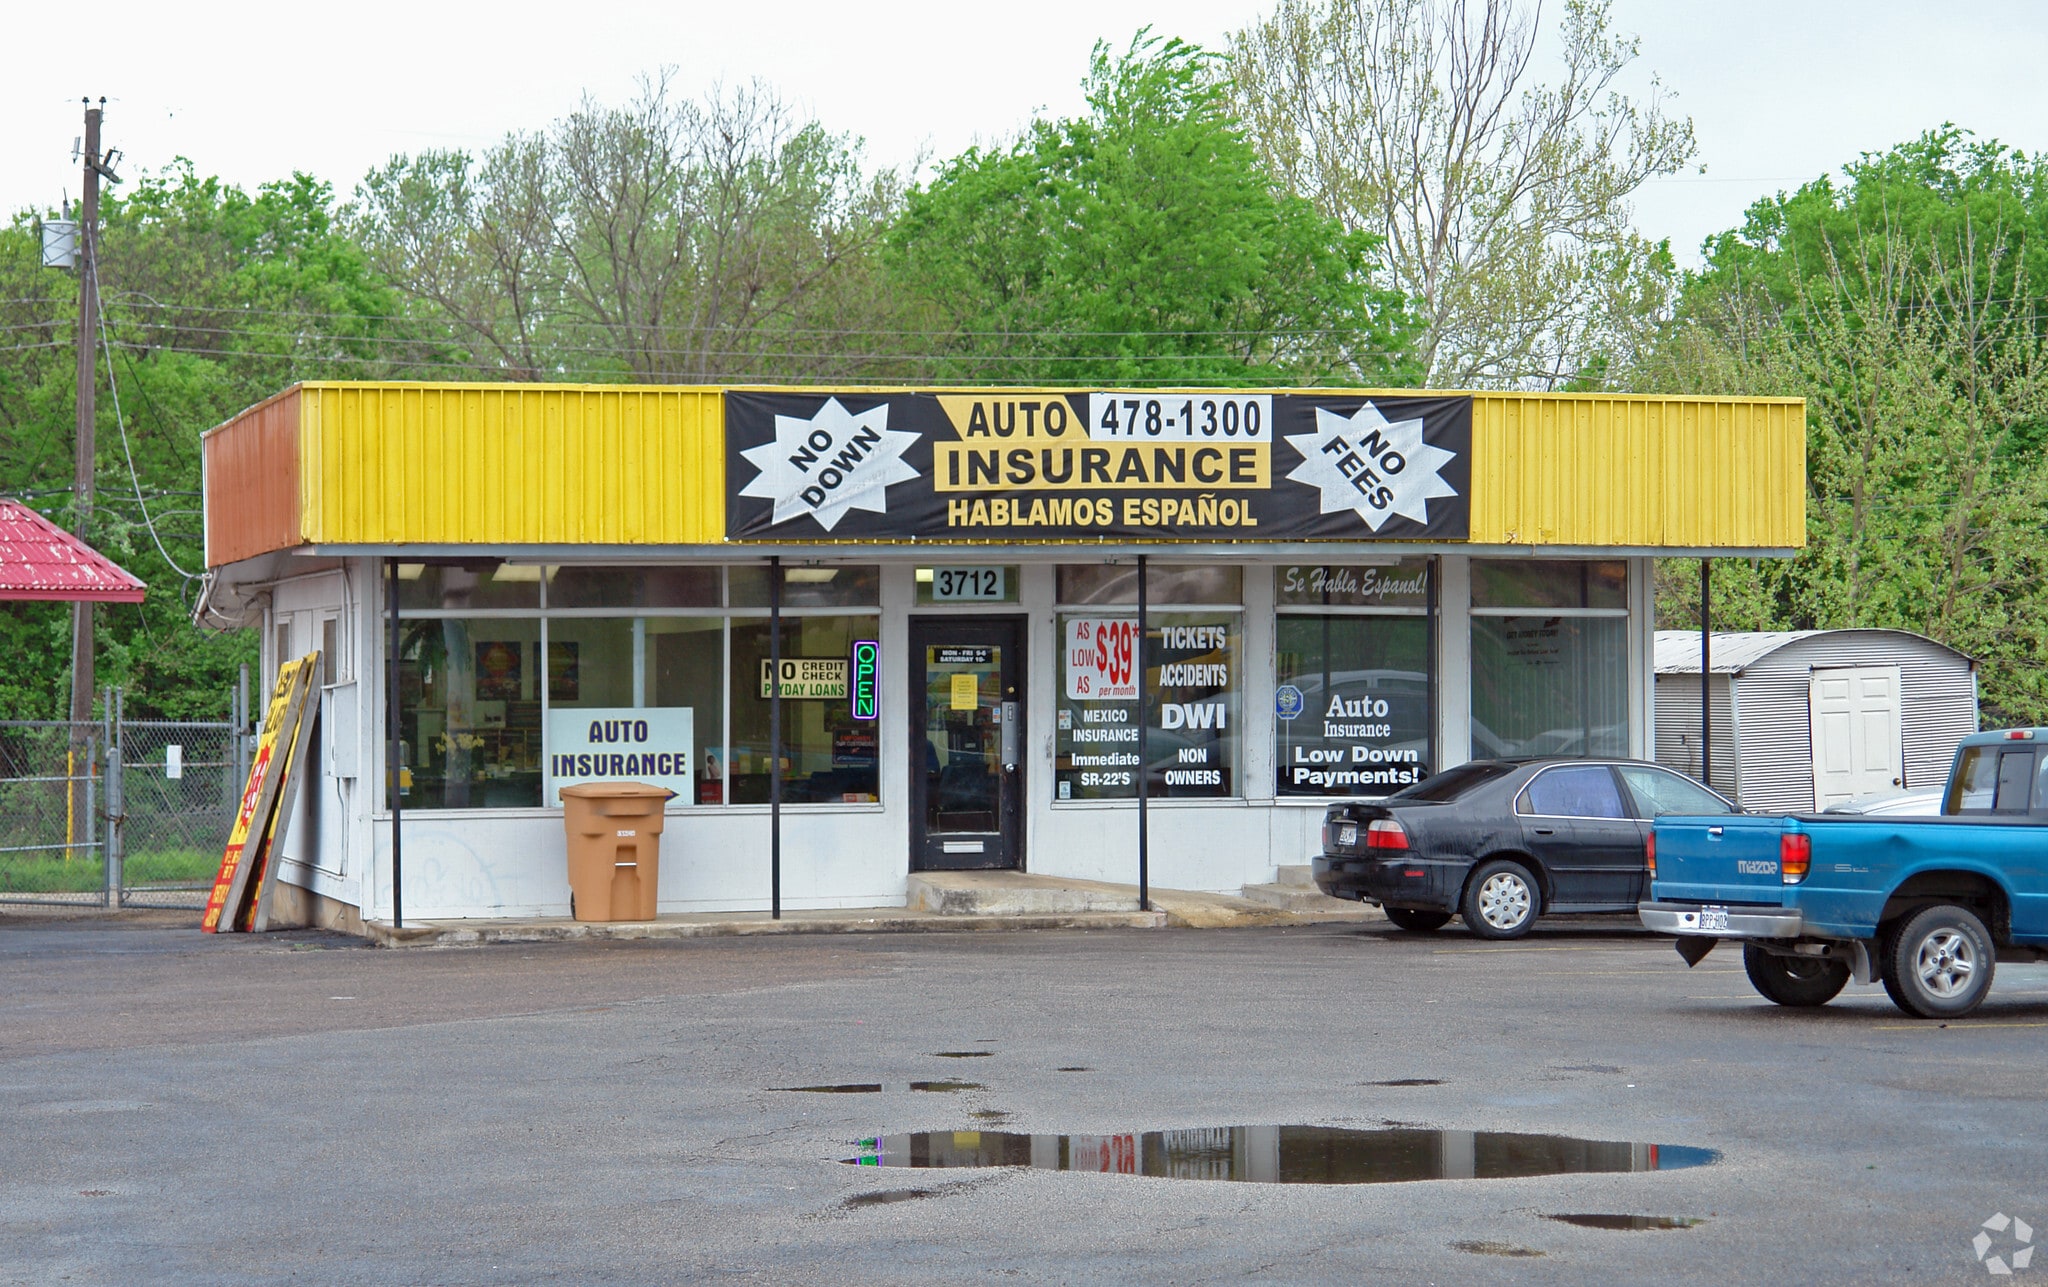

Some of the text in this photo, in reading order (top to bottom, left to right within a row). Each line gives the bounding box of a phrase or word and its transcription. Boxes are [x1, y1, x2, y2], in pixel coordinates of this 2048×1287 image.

[967, 401, 1067, 437] AUTO
[1101, 399, 1261, 437] 478-1300
[788, 429, 833, 473] NO
[1358, 429, 1406, 476] NO
[800, 425, 882, 509] DOWN
[948, 447, 1258, 486] INSURANCE
[1321, 435, 1394, 511] FEES
[948, 492, 1257, 526] HABLAMOS ESPAÑOL
[939, 570, 997, 597] 3712
[1284, 567, 1427, 600] Se Habla Espanol!
[1077, 622, 1090, 640] AS
[1161, 626, 1226, 649] TICKETS
[802, 662, 845, 671] CREDIT
[1072, 649, 1095, 667] LOW
[802, 671, 842, 681] CHECK
[858, 645, 876, 716] OPEN
[1077, 676, 1090, 693] AS
[1159, 664, 1227, 687] ACCIDENTS
[764, 683, 845, 696] PYDAY LOANS
[1099, 685, 1136, 698] per month
[1084, 709, 1128, 723] MEXICO
[1161, 703, 1225, 729] DWI
[1326, 694, 1389, 718] Auto
[588, 720, 648, 743] AUTO
[1073, 729, 1139, 742] INSURANCE
[1324, 720, 1391, 738] Insurance
[552, 753, 686, 777] INSURANCE
[1072, 752, 1140, 766] Immediate
[1178, 748, 1207, 763] NON
[1295, 746, 1418, 763] Low Down
[1165, 770, 1221, 785] OWNERS
[1294, 767, 1419, 788] Payments!
